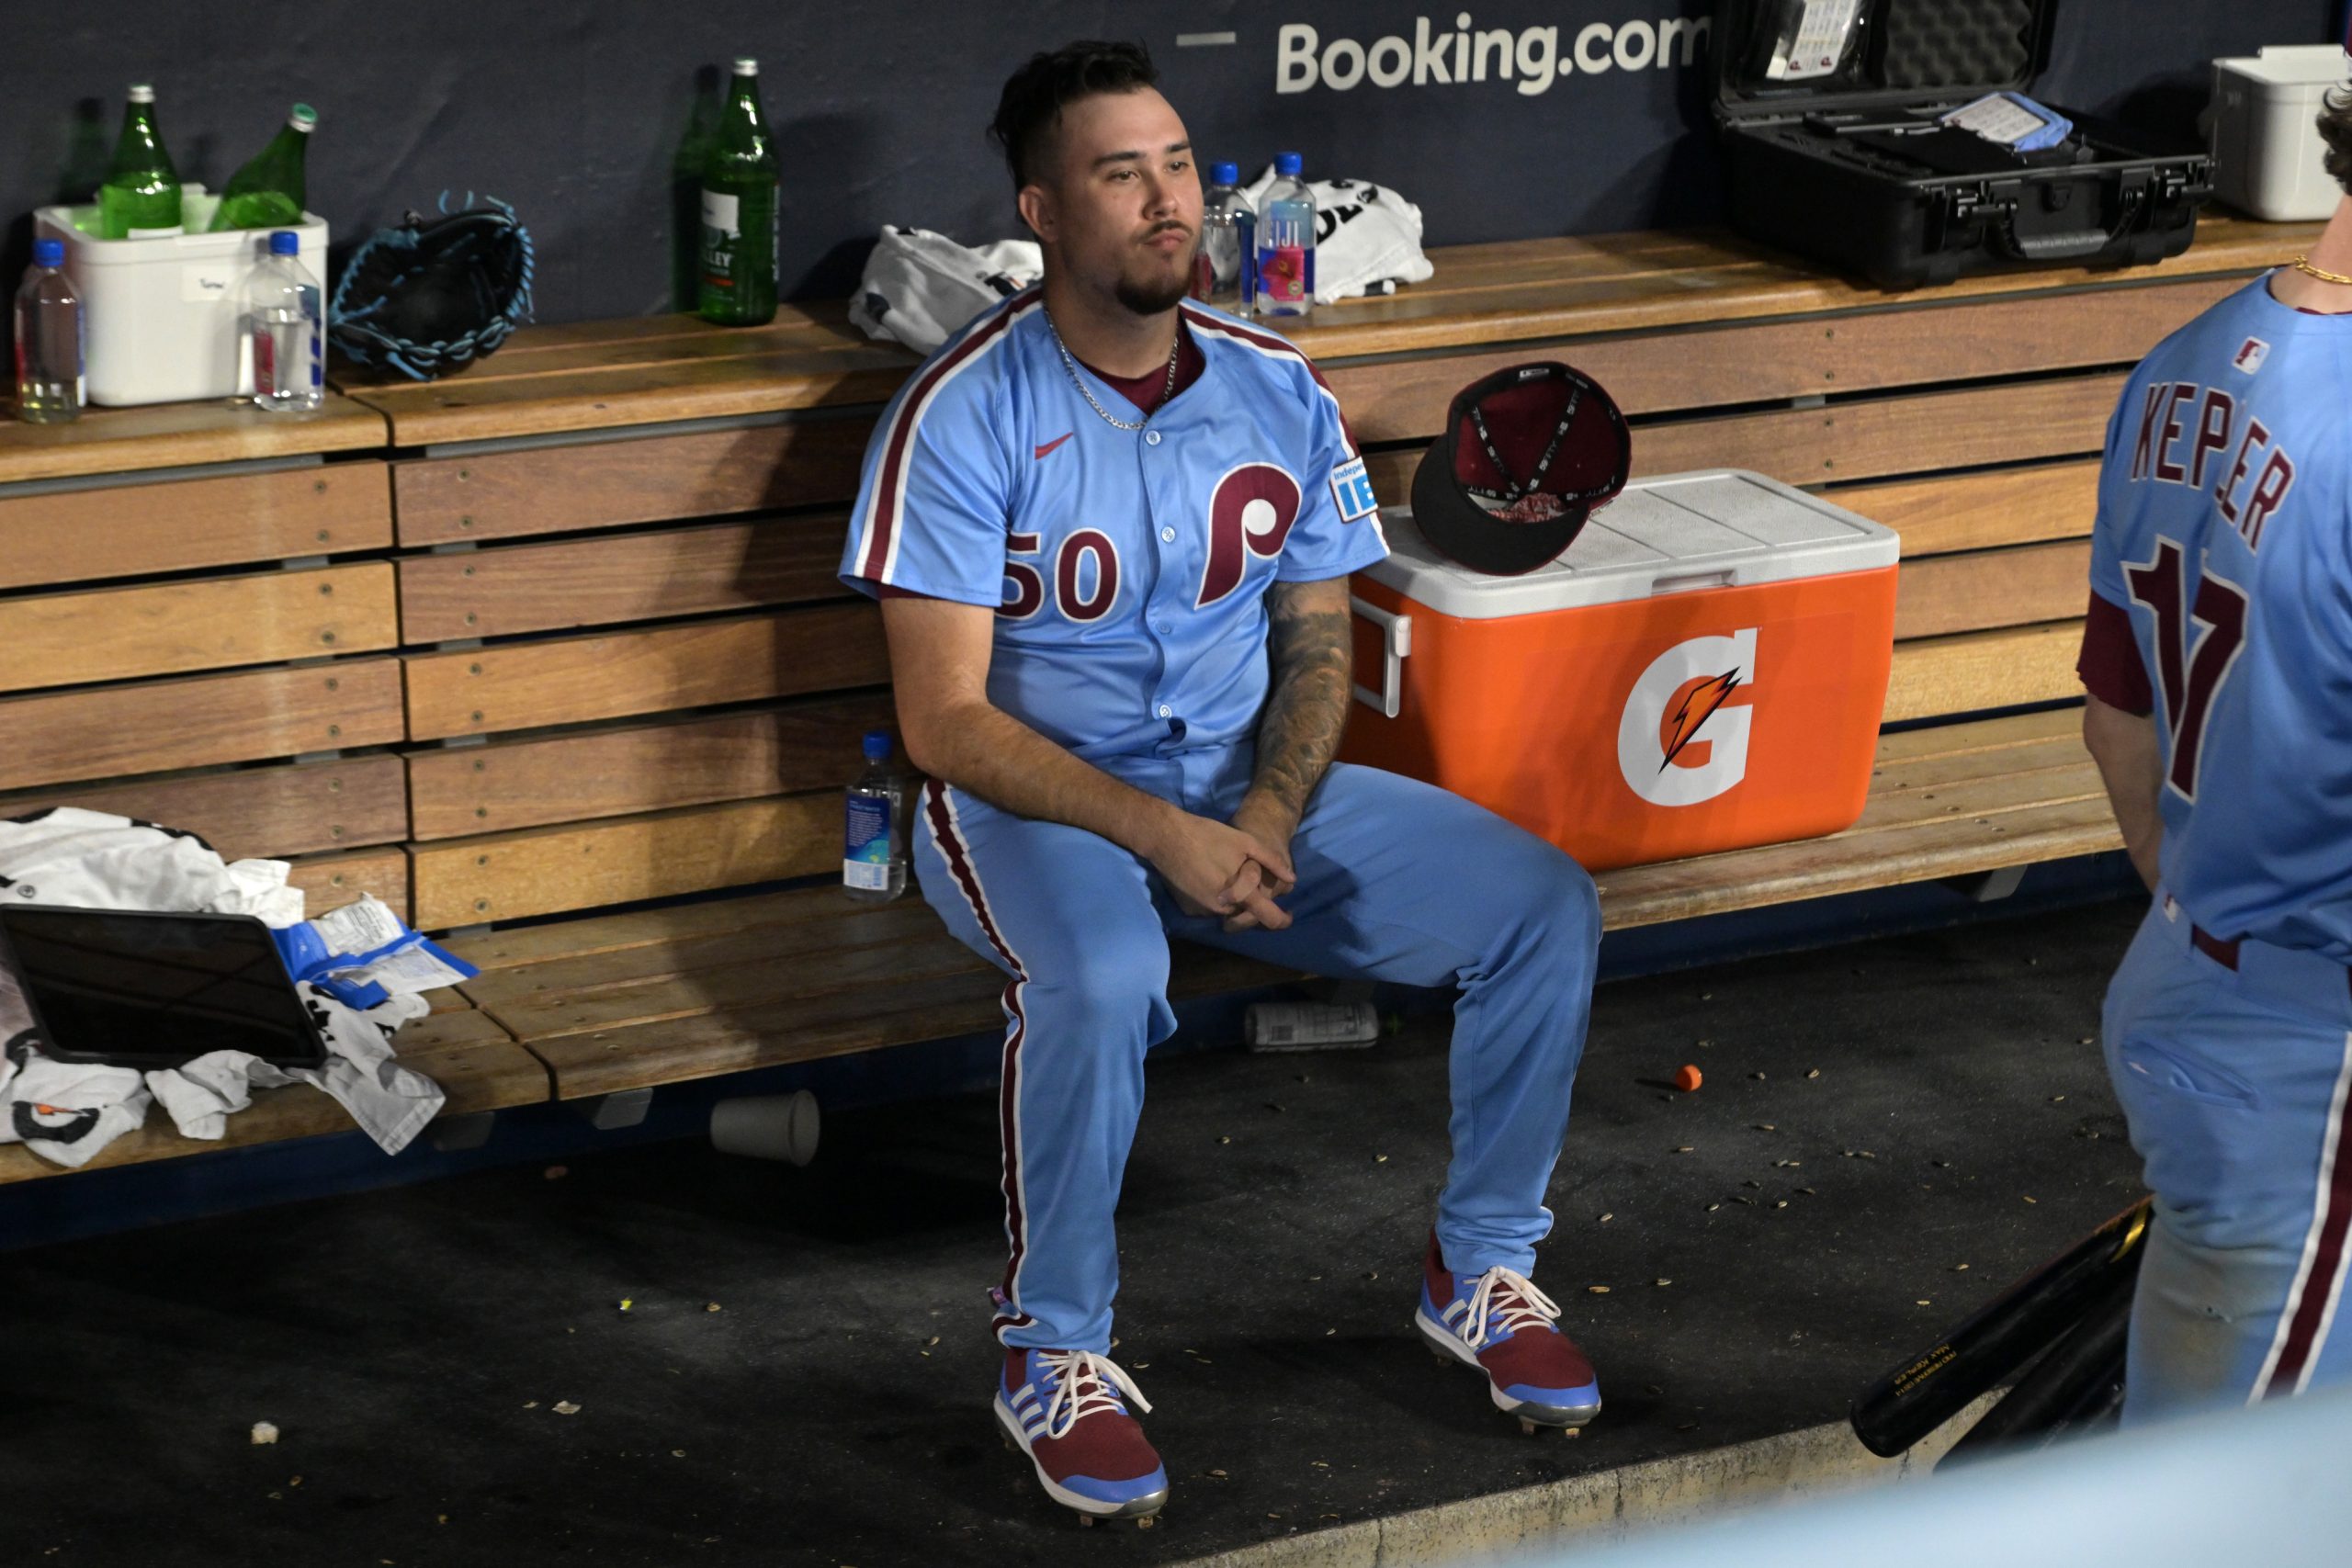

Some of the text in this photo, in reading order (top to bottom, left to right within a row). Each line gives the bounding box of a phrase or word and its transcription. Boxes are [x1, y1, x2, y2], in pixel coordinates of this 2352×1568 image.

[1276, 12, 1713, 96] Booking.com
[1194, 461, 1302, 610] P
[2130, 382, 2296, 557] KEPER
[993, 527, 1121, 624] 50
[1617, 627, 1758, 807] G
[2120, 534, 2249, 806] 17
